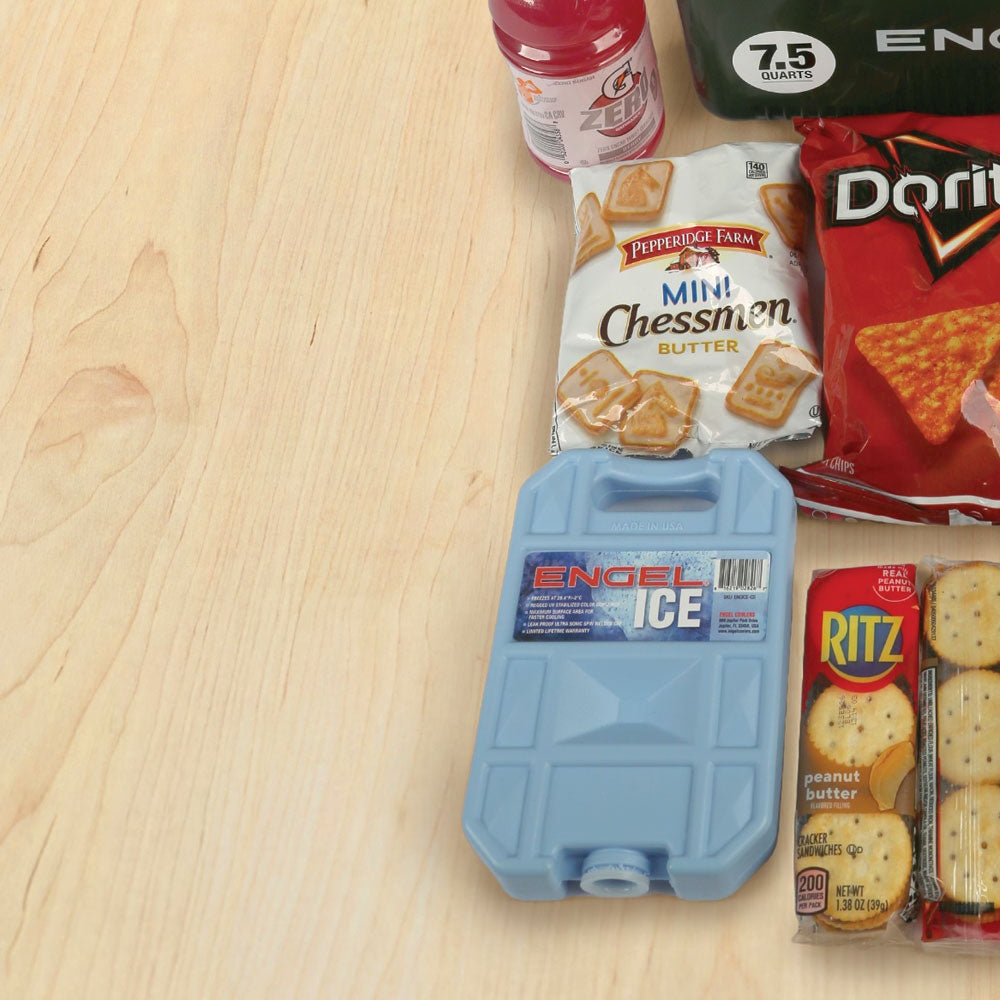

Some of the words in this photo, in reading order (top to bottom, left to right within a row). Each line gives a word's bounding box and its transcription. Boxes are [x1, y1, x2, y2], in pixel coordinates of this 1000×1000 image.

[749, 43, 817, 71] 7.5
[761, 70, 813, 81] QUARTS
[749, 162, 765, 170] 140
[631, 230, 712, 259] PEPPERIDGE
[716, 228, 754, 245] FARM
[662, 275, 731, 307] MINI
[598, 298, 792, 347] Chessmen
[658, 339, 739, 355] BUTTER
[830, 456, 855, 475] CHIPS
[611, 521, 645, 531] MADE
[647, 521, 657, 531] IN
[662, 521, 684, 531] USA
[533, 566, 704, 588] ENGEL
[882, 569, 908, 578] REAL
[878, 578, 911, 586] PEANUT
[633, 588, 702, 630] ICE
[821, 610, 904, 665] RITZ
[804, 771, 860, 788] peanut
[806, 787, 858, 801] butter
[797, 832, 828, 847] CRACKER
[797, 844, 842, 859] SANDWICHES
[800, 874, 824, 893] 200
[836, 885, 850, 897] NET
[851, 885, 864, 897] WT
[798, 892, 824, 900] CALORIES
[799, 901, 808, 909] PER
[808, 900, 822, 908] PACK
[836, 900, 852, 911] 1.38
[854, 900, 865, 911] OZ
[867, 900, 889, 912] (39g)
